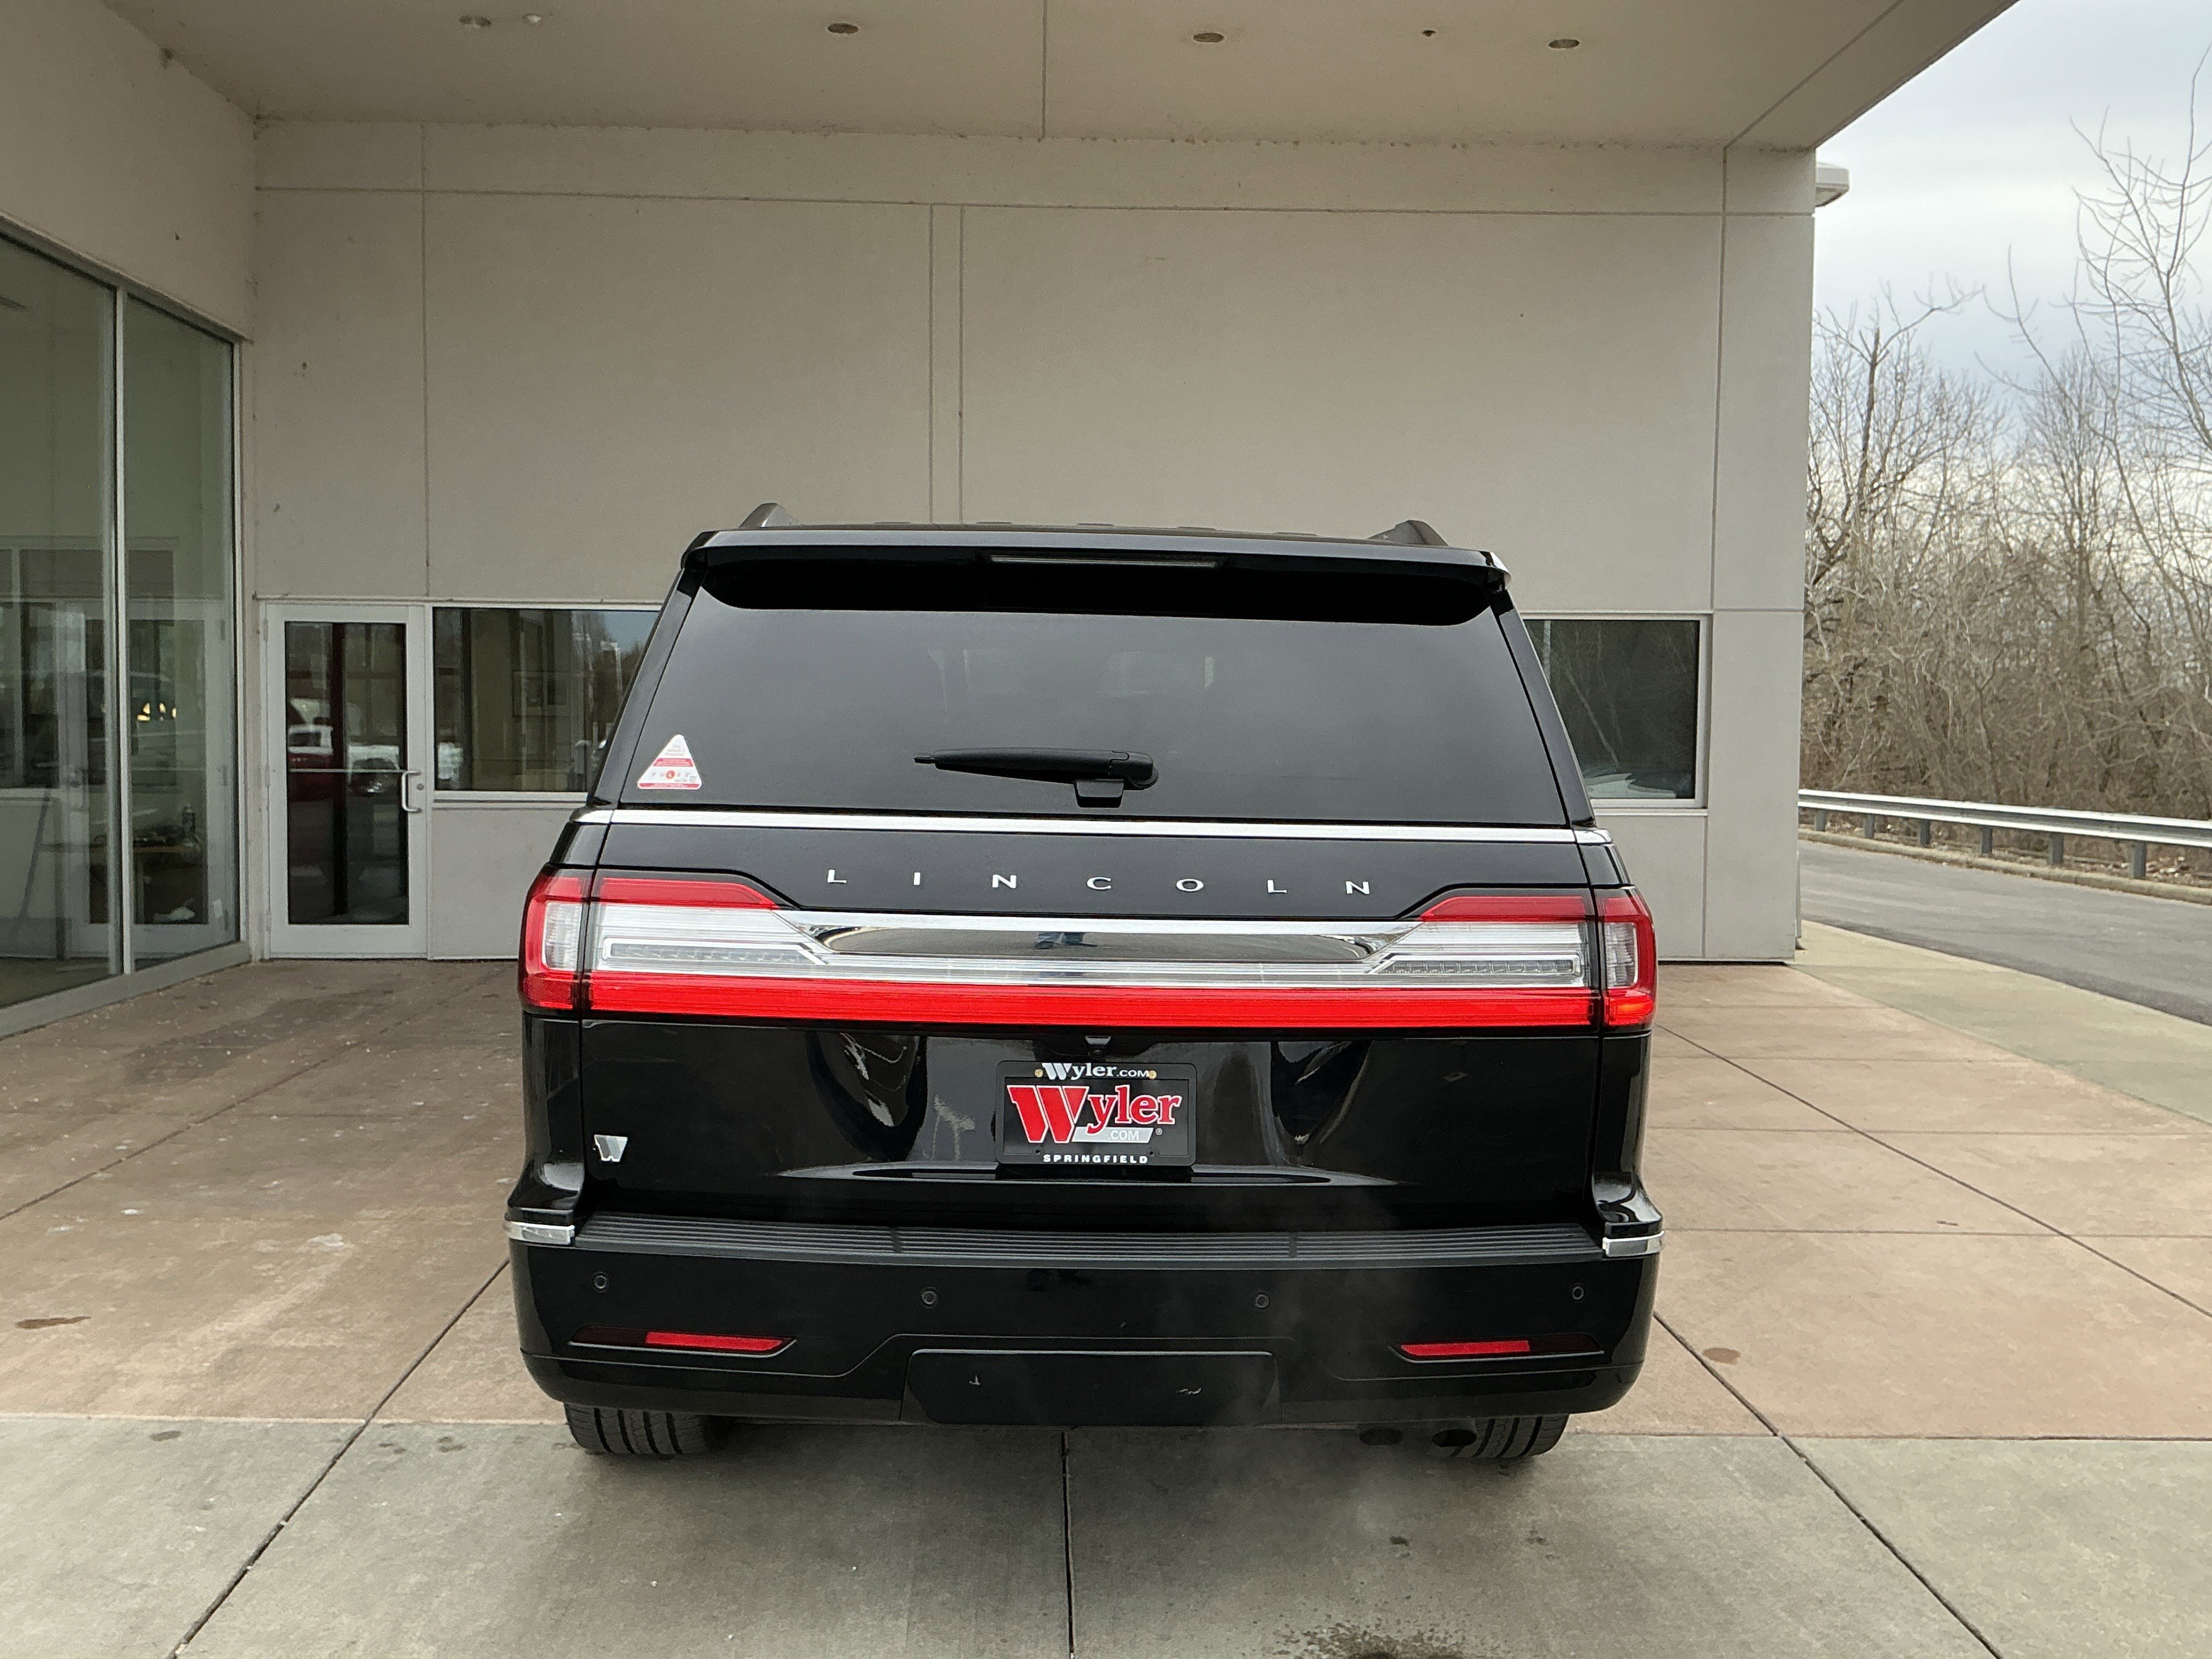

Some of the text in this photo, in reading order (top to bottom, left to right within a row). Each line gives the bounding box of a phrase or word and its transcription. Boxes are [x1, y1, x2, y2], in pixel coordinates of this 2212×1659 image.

[826, 869, 1370, 895] LINCOLN
[1006, 1084, 1182, 1143] Wyler
[1043, 1154, 1148, 1164] SPRINGFIELD
